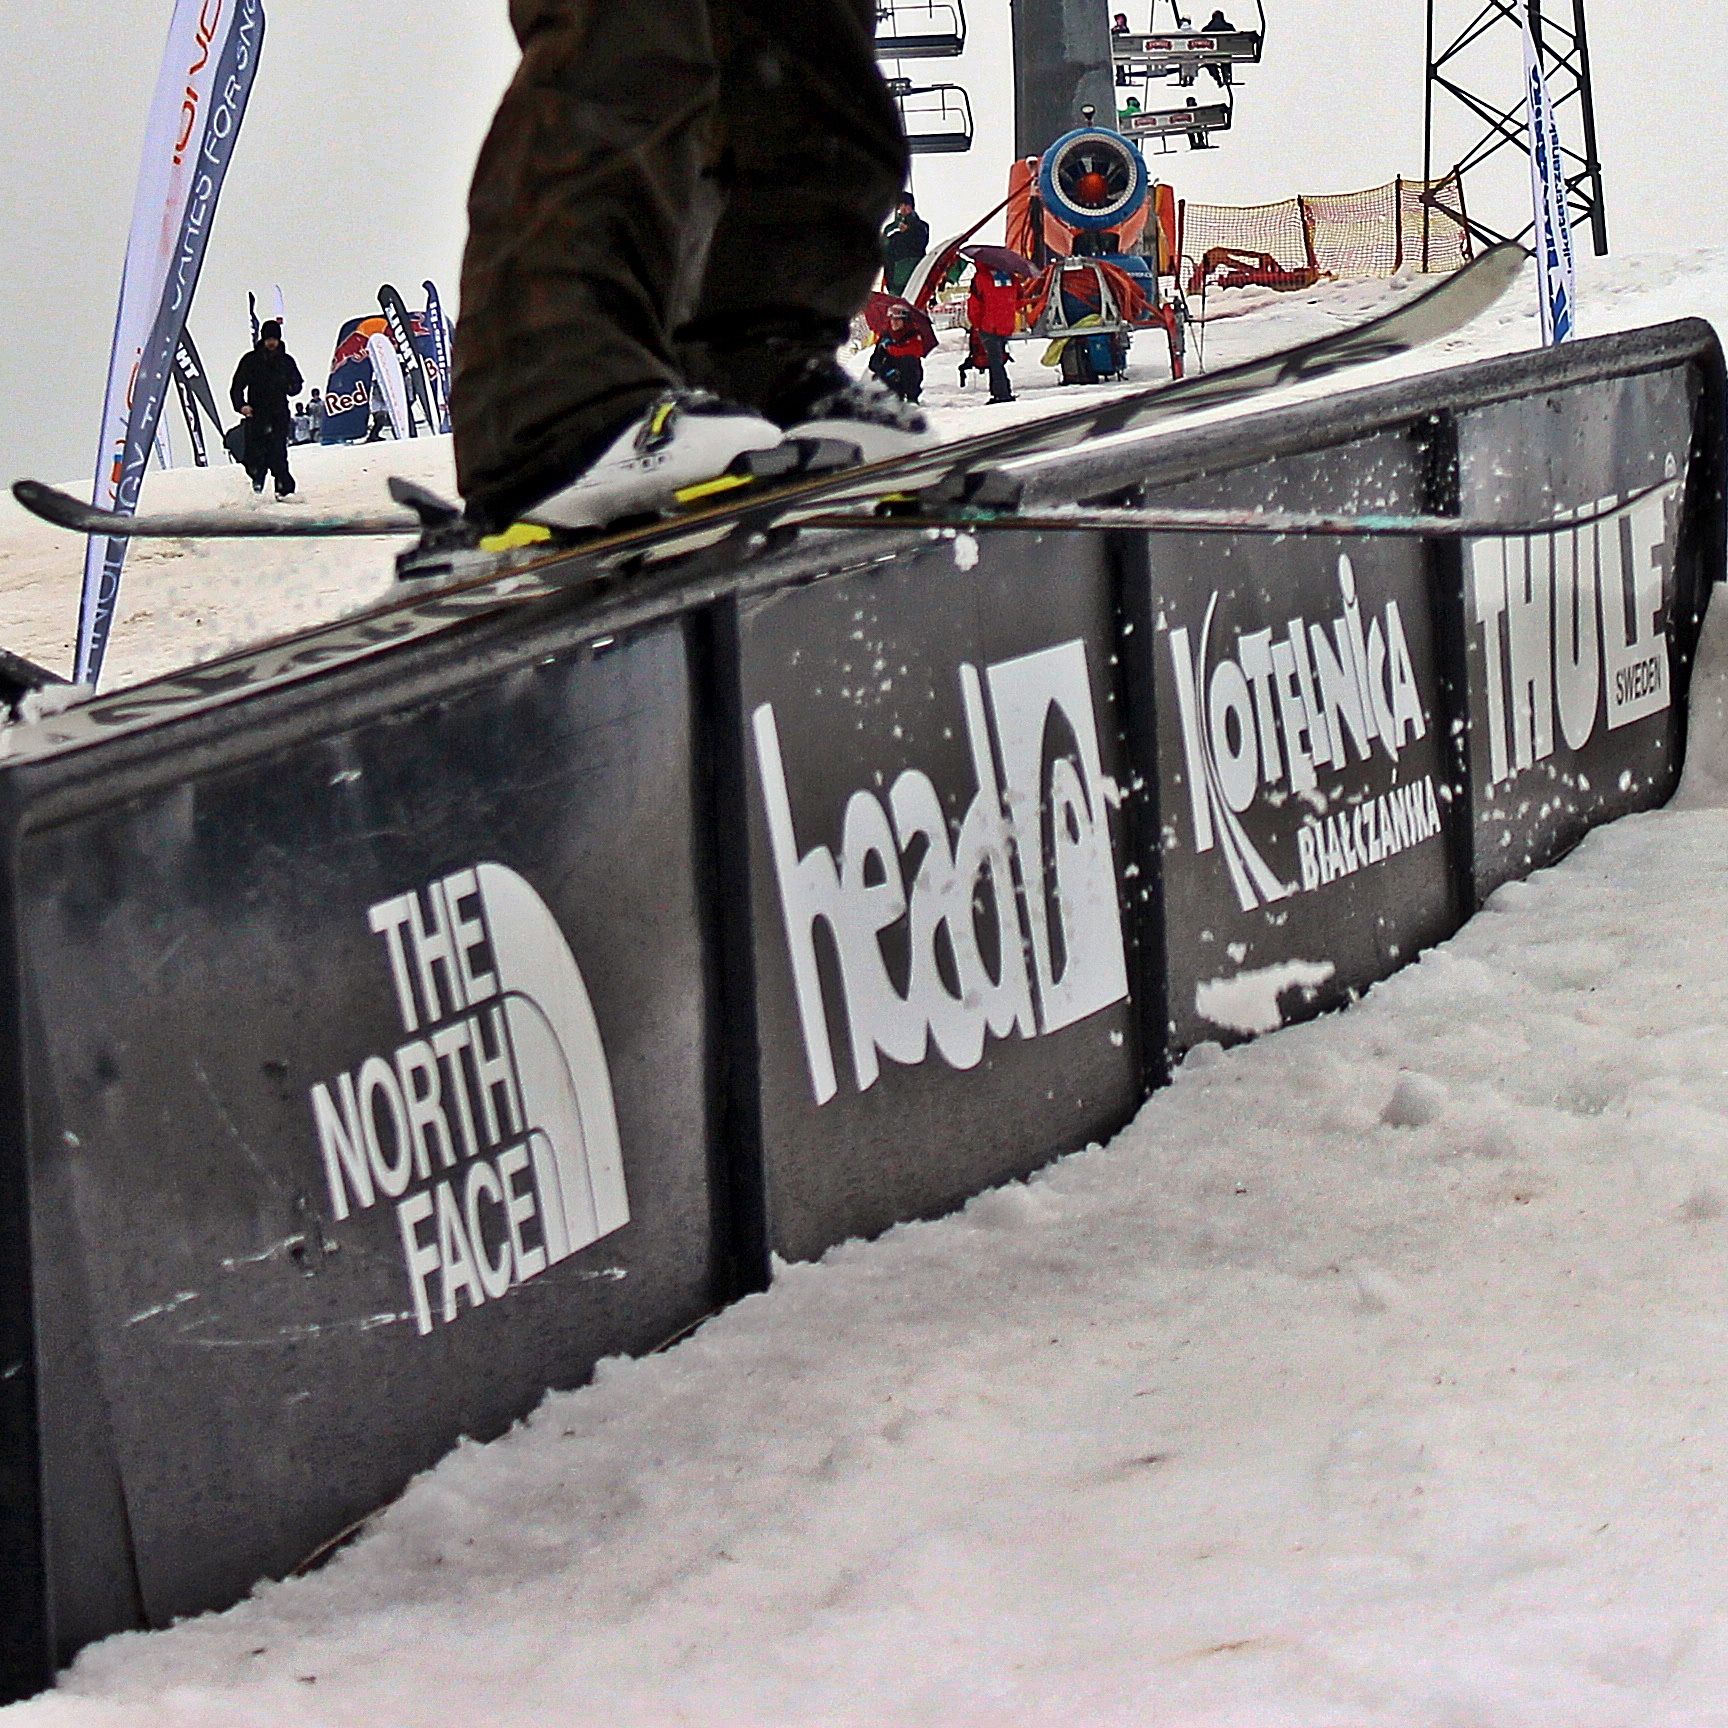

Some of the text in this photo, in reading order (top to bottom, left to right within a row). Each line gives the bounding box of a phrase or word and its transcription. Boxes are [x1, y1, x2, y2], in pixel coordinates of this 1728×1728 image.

[325, 381, 368, 417] Red
[1472, 484, 1672, 786] THULE
[1615, 655, 1663, 707] SWEDEN
[368, 867, 500, 1033] THE
[752, 662, 1038, 1107] head
[310, 1002, 524, 1222] NORTH
[395, 1138, 548, 1337] FACE
